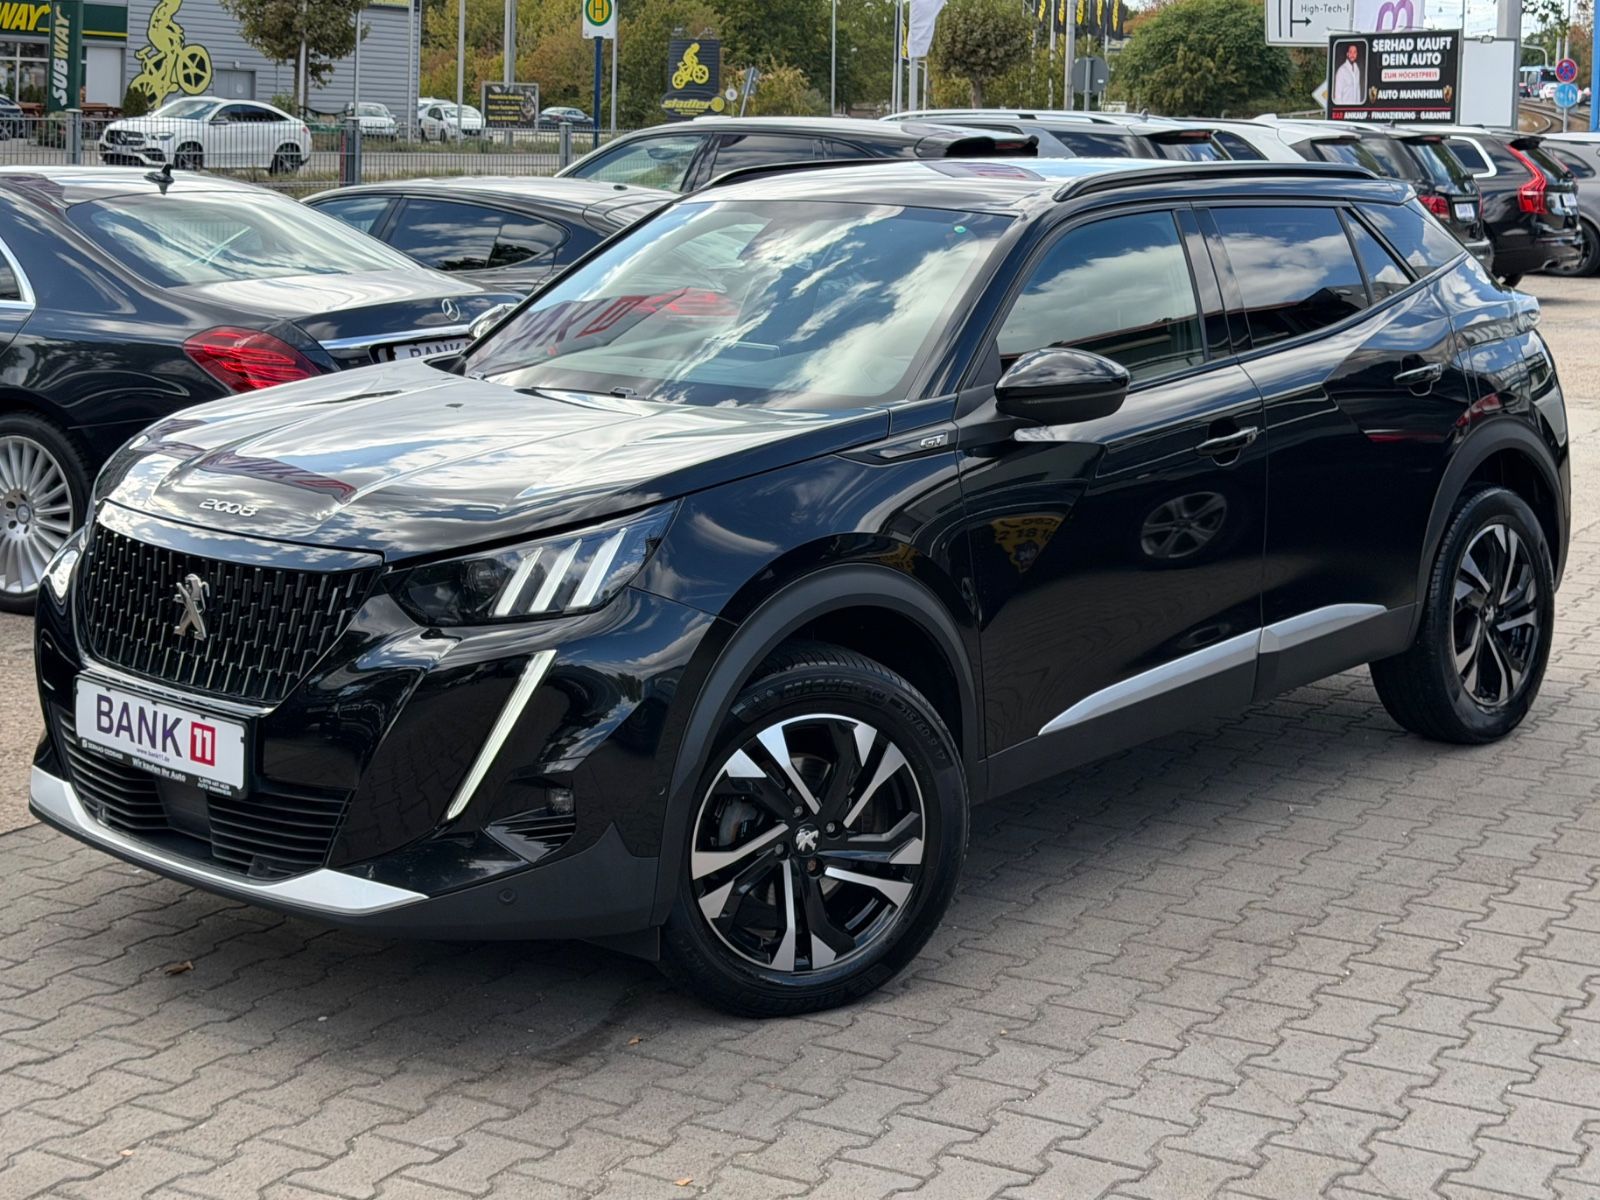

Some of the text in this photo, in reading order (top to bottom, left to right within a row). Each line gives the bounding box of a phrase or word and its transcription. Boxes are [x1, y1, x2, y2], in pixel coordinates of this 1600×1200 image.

[1372, 36, 1452, 52] SERHAD KAUFT
[52, 5, 70, 106] SUBWAY
[1382, 52, 1441, 66] DEIN AUTO
[1377, 88, 1443, 99] AUTO MANNHEIM
[1420, 111, 1451, 120] GARANTIE
[199, 498, 259, 517] 2008
[96, 693, 183, 759] BANK
[170, 770, 186, 783] Auto
